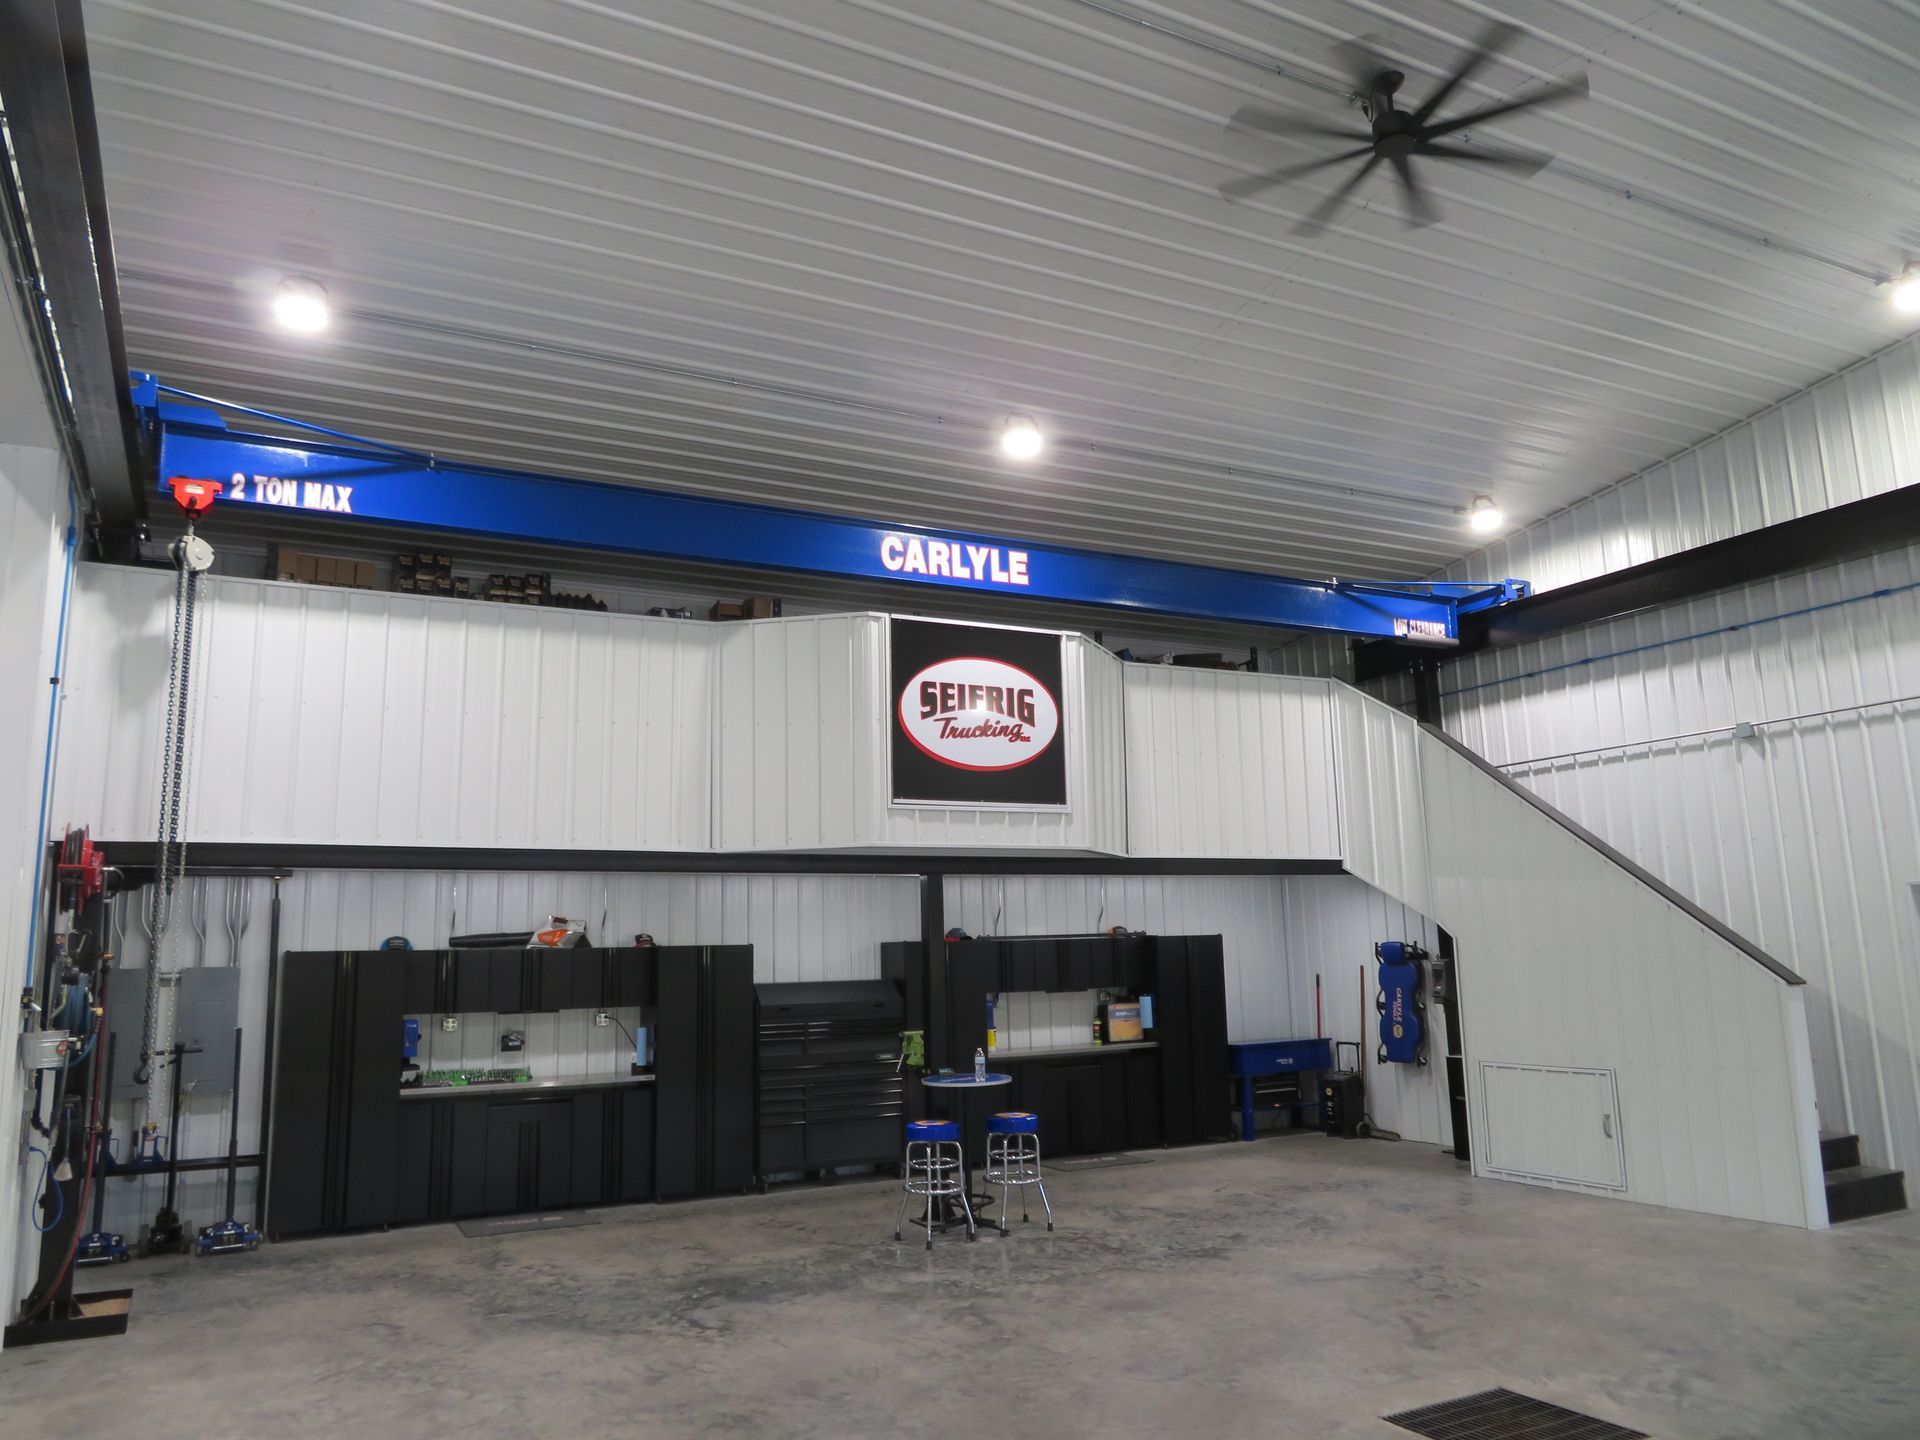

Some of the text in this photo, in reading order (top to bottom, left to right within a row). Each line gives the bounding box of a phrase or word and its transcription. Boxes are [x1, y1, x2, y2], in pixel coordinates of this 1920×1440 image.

[230, 473, 353, 513] 2 TON MAX
[881, 536, 1030, 585] CARLYLE
[920, 680, 1036, 728] SEIFRIG
[933, 716, 1024, 743] Trucking
